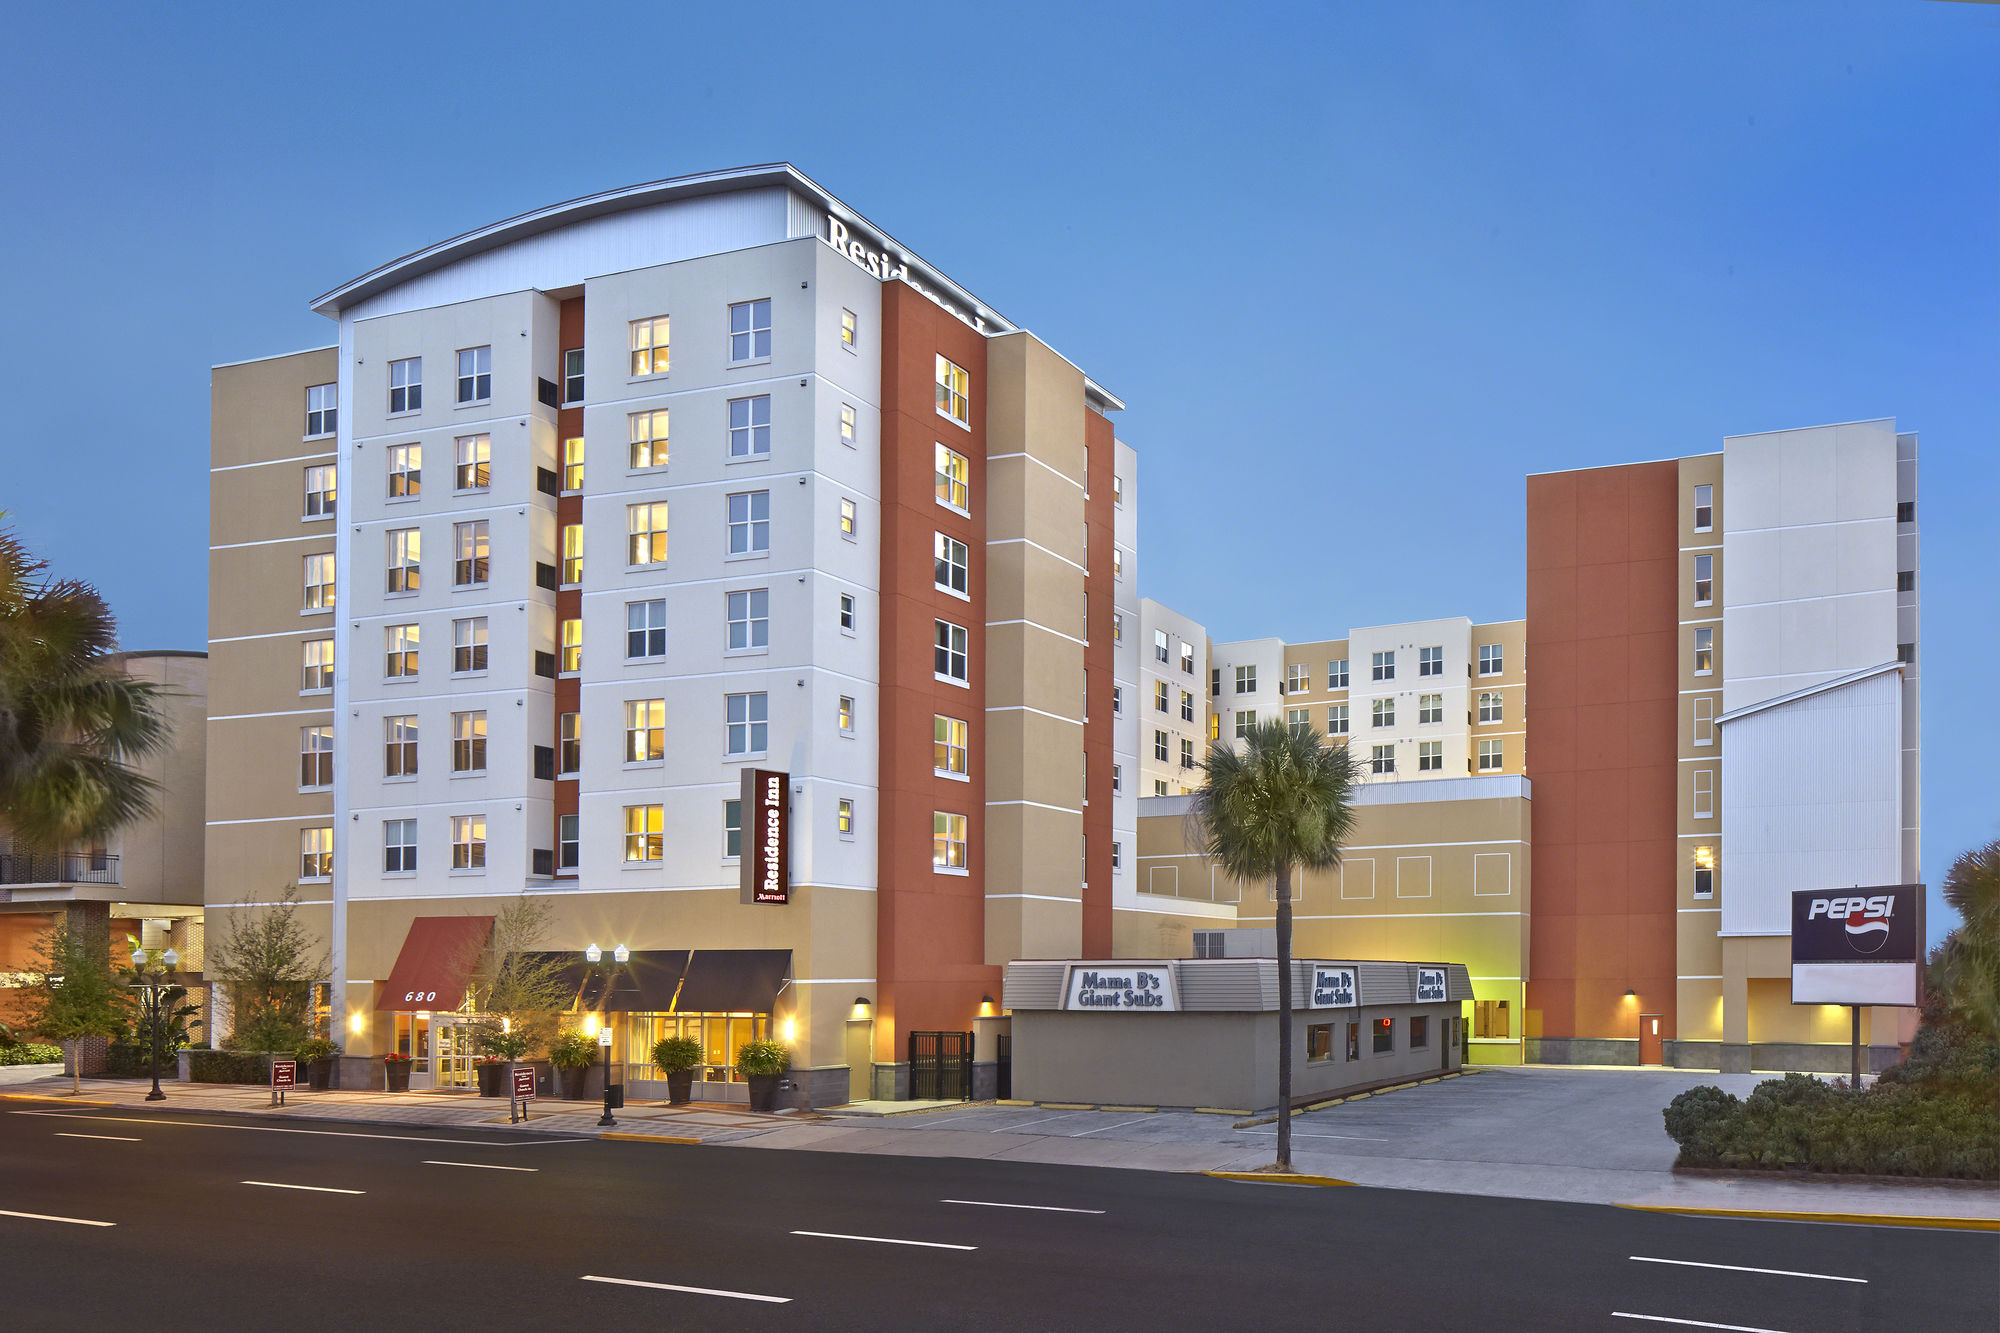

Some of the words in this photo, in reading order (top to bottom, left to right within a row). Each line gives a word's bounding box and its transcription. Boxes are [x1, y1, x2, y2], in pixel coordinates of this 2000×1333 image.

[764, 776, 780, 807] Inn
[764, 808, 780, 891] Residence
[757, 893, 786, 901] Marriott
[1808, 895, 1895, 920] PEPSI
[1081, 971, 1132, 989] Mama
[1136, 971, 1160, 989] B's
[1316, 971, 1340, 988] Mama
[405, 991, 437, 1002] 680
[1078, 989, 1121, 1007] Giant
[1123, 989, 1164, 1007] Subs
[1314, 988, 1334, 1005] Giant
[1335, 988, 1353, 1005] Subs
